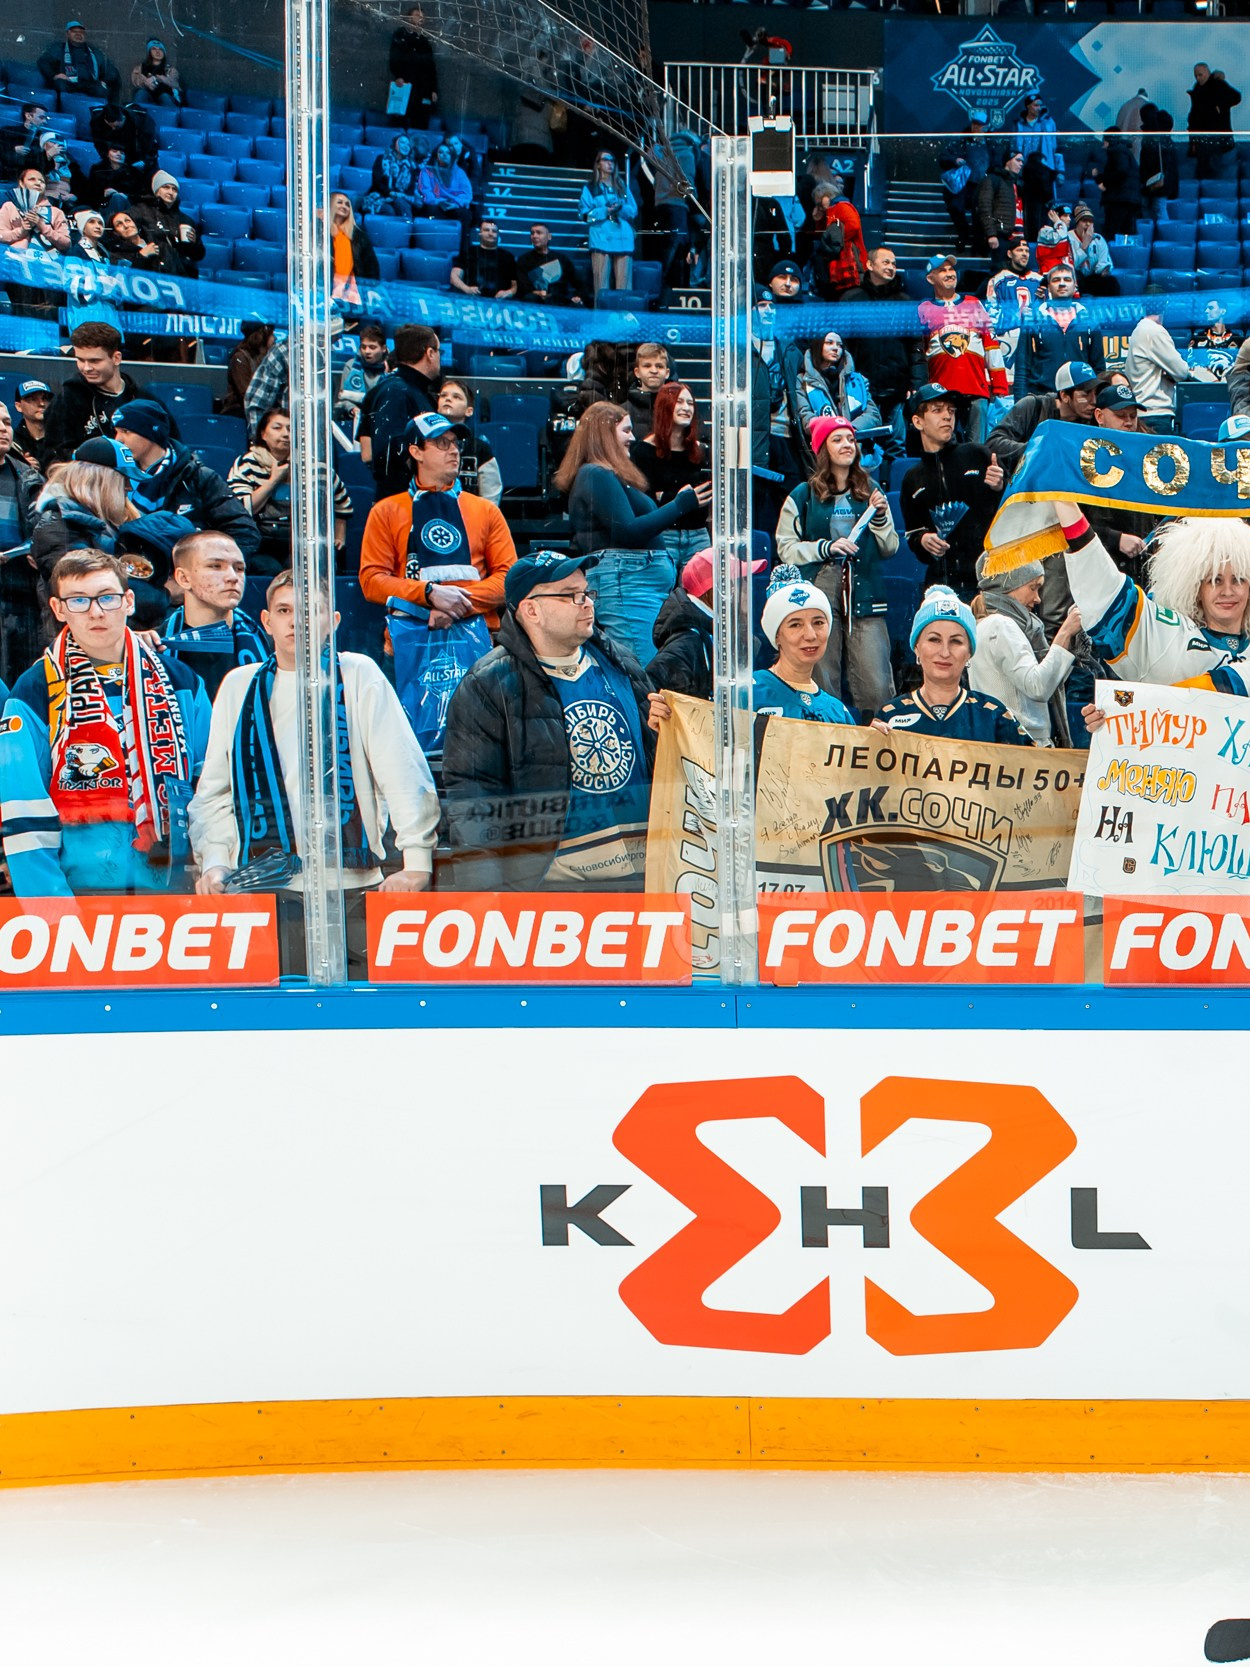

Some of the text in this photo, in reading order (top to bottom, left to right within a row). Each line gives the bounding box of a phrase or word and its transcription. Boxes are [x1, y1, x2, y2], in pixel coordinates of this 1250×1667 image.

[968, 55, 1005, 64] FONBET
[980, 64, 1034, 87] STAR
[831, 159, 855, 174] A2
[678, 296, 702, 309] 10
[667, 328, 681, 343] 9
[894, 717, 912, 725] МИР
[1105, 708, 1207, 751] ТИМУР
[569, 740, 634, 790] ОВОСИБИРСК
[824, 744, 1025, 790] ЛЕОПАРДЫ
[1033, 769, 1085, 792] 50+
[58, 777, 123, 791] TRAKTOR
[1094, 806, 1134, 844] НА
[0, 910, 271, 975] ONBET
[375, 909, 685, 968] FONBET
[765, 910, 1077, 968] FONBET
